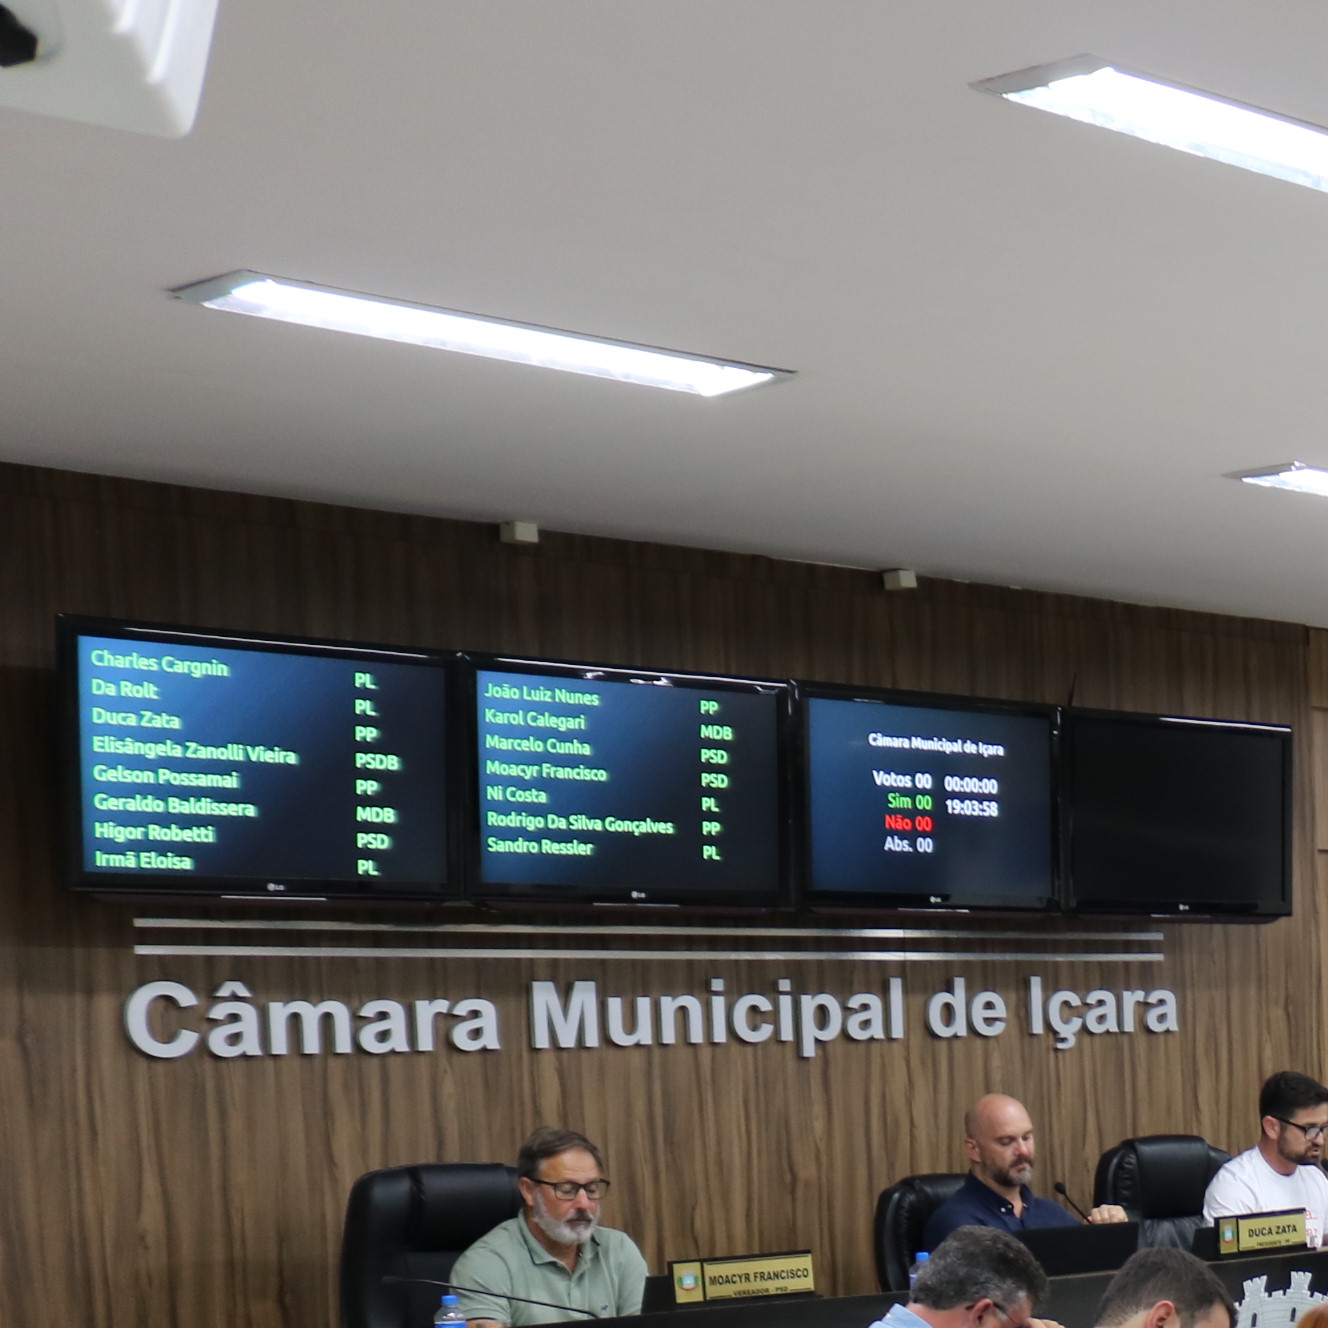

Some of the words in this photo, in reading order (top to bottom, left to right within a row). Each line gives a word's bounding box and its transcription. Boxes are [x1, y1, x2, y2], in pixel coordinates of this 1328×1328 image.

[91, 650, 159, 670] Charles
[160, 656, 229, 677] Cargnin
[92, 679, 117, 696] Da
[120, 681, 159, 699] Rolt
[355, 673, 377, 689] PL
[485, 683, 520, 699] João
[523, 686, 552, 702] Luiz
[555, 688, 599, 705] Nunes
[355, 699, 377, 715] PL
[700, 701, 718, 714] PP
[92, 708, 138, 726] Duca
[139, 711, 181, 729] Zata
[485, 709, 524, 725] Karol
[527, 712, 585, 731] Calegari
[355, 726, 379, 741] PP
[701, 725, 732, 740] MDB
[93, 736, 184, 759] Elisângela
[183, 742, 245, 760] Zanolli
[245, 746, 298, 764] Vieira
[486, 734, 544, 752] Marcelo
[546, 738, 591, 755] Cunha
[869, 733, 910, 748] Câmara
[911, 737, 962, 754] Municipal
[963, 740, 978, 753] de
[979, 742, 1004, 757] Içara
[356, 753, 400, 770] PSDB
[701, 749, 728, 764] PSD
[93, 765, 156, 783] Gelson
[158, 769, 239, 788] Possamai
[487, 760, 540, 779] Moacyr
[542, 763, 607, 781] Francisco
[356, 780, 380, 795] PP
[702, 773, 728, 788] PSD
[873, 770, 912, 787] Votos
[915, 773, 932, 789] 00
[945, 776, 998, 794] 00:00:00
[487, 786, 503, 800] Ni
[506, 787, 547, 803] Costa
[888, 793, 911, 808] Sim
[916, 795, 932, 810] 00
[94, 794, 166, 812] Geraldo
[166, 797, 257, 816] Baldissera
[702, 797, 719, 812] PL
[946, 799, 998, 817] 19:03:58
[357, 806, 396, 823] MDB
[886, 815, 913, 830] Não
[915, 816, 932, 831] 00
[95, 822, 146, 842] Higor
[146, 824, 215, 842] Robetti
[488, 812, 545, 830] Rodrigo
[547, 814, 567, 829] Da
[569, 815, 603, 830] Silva
[605, 817, 674, 836] Gonçalves
[703, 821, 721, 835] PP
[357, 833, 390, 849] PSD
[488, 837, 539, 853] Sandro
[541, 839, 593, 855] Ressler
[884, 836, 913, 852] Abs.
[917, 838, 933, 852] 00
[96, 851, 138, 867] Irmã
[139, 852, 193, 869] Eloisa
[703, 846, 720, 860] PL
[358, 860, 379, 875] PL
[127, 981, 501, 1057] Câmara
[533, 978, 904, 1057] Municipal
[929, 977, 1008, 1037] de
[1031, 977, 1179, 1049] Içara
[1248, 1227, 1273, 1238] DUCA
[1275, 1224, 1298, 1235] ZATA
[708, 1273, 751, 1286] MOACYR
[753, 1268, 809, 1282] FRANCISCO
